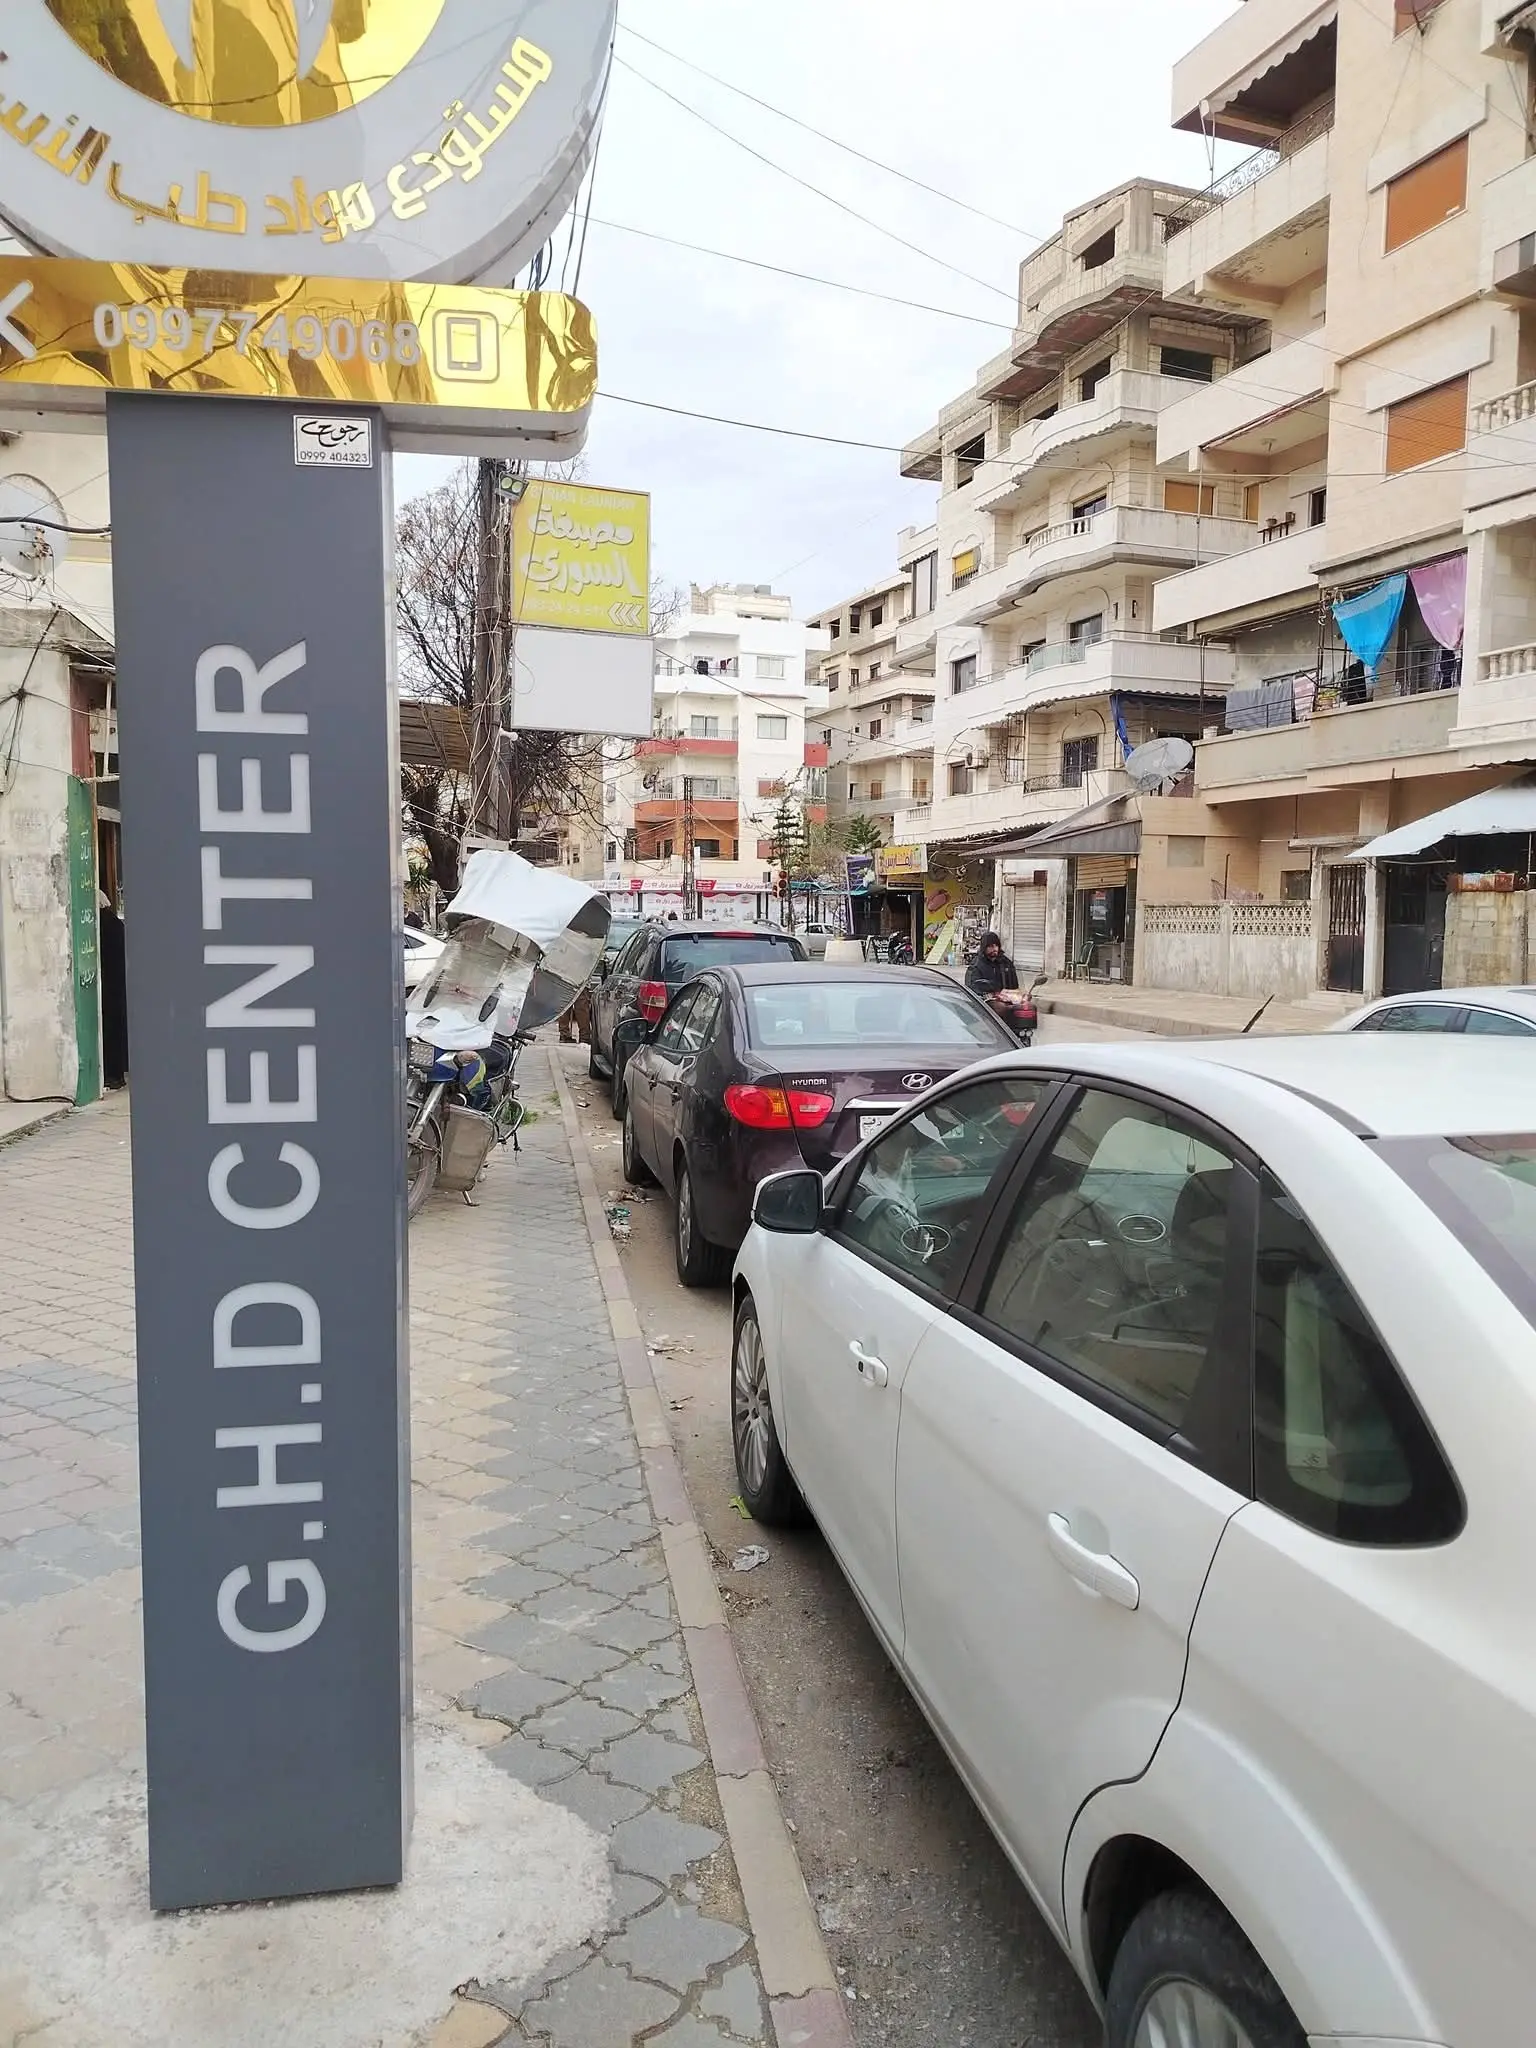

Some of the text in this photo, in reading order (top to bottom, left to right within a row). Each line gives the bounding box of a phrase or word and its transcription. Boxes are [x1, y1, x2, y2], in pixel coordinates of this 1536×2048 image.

[387, 36, 553, 220] مستودع
[105, 161, 248, 234] طب
[263, 175, 376, 244] مواد
[93, 302, 421, 366] 0997749068
[300, 450, 368, 463] 0999 404323
[529, 504, 634, 551] مصبغة
[521, 551, 642, 597] السوري
[792, 1078, 828, 1086] HYUNDAI
[194, 638, 326, 1653] G.H.D CENTER
